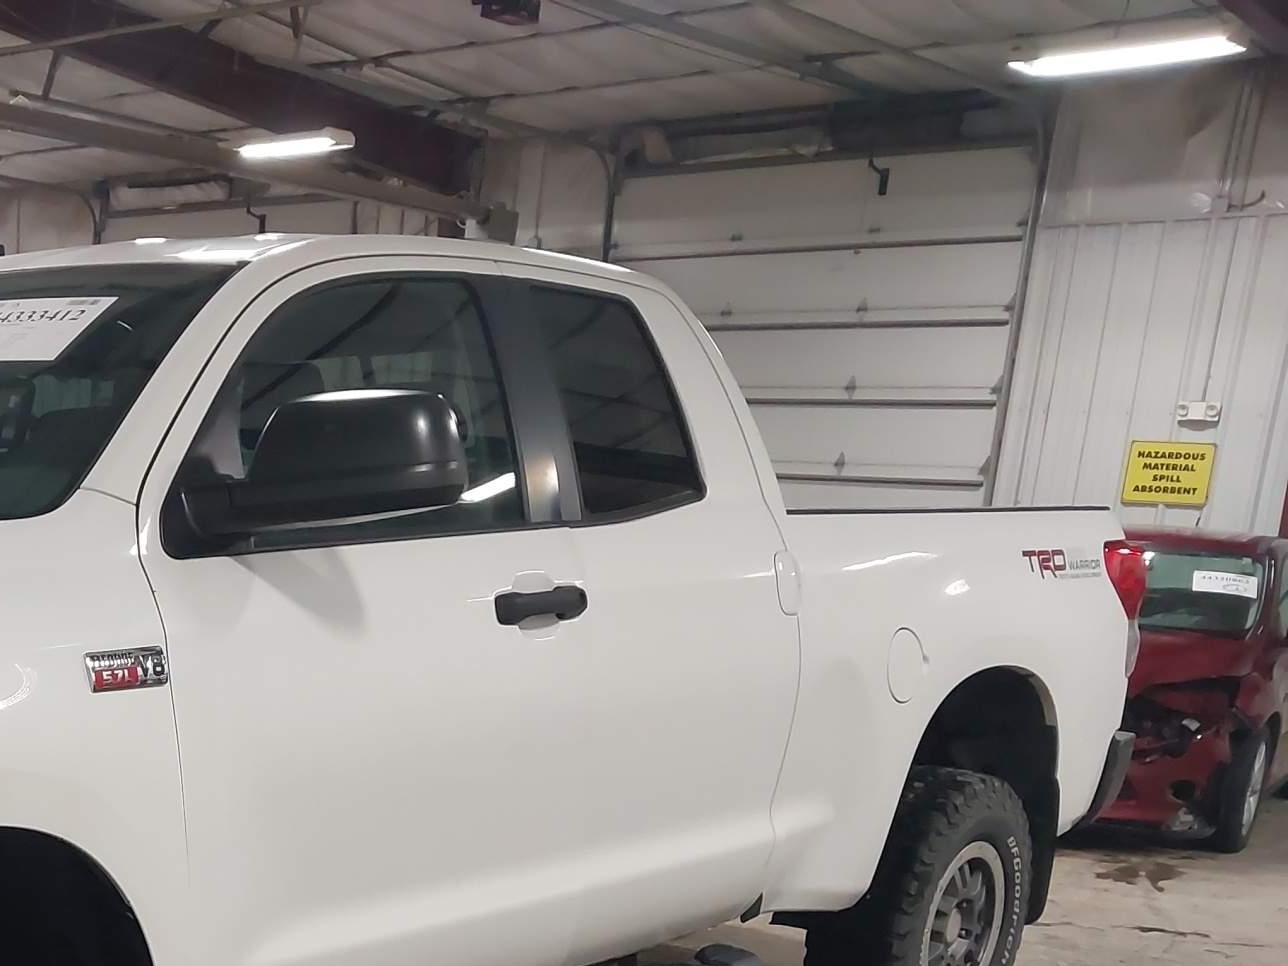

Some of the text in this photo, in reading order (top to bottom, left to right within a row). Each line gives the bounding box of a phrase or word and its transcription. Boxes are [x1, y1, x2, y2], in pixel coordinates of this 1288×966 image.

[1137, 451, 1206, 461] HAZARDOUS
[1142, 462, 1196, 472] MATERIAL
[1152, 474, 1182, 483] SPILL
[1132, 485, 1198, 496] ABSORBENT
[1022, 549, 1067, 580] TRD
